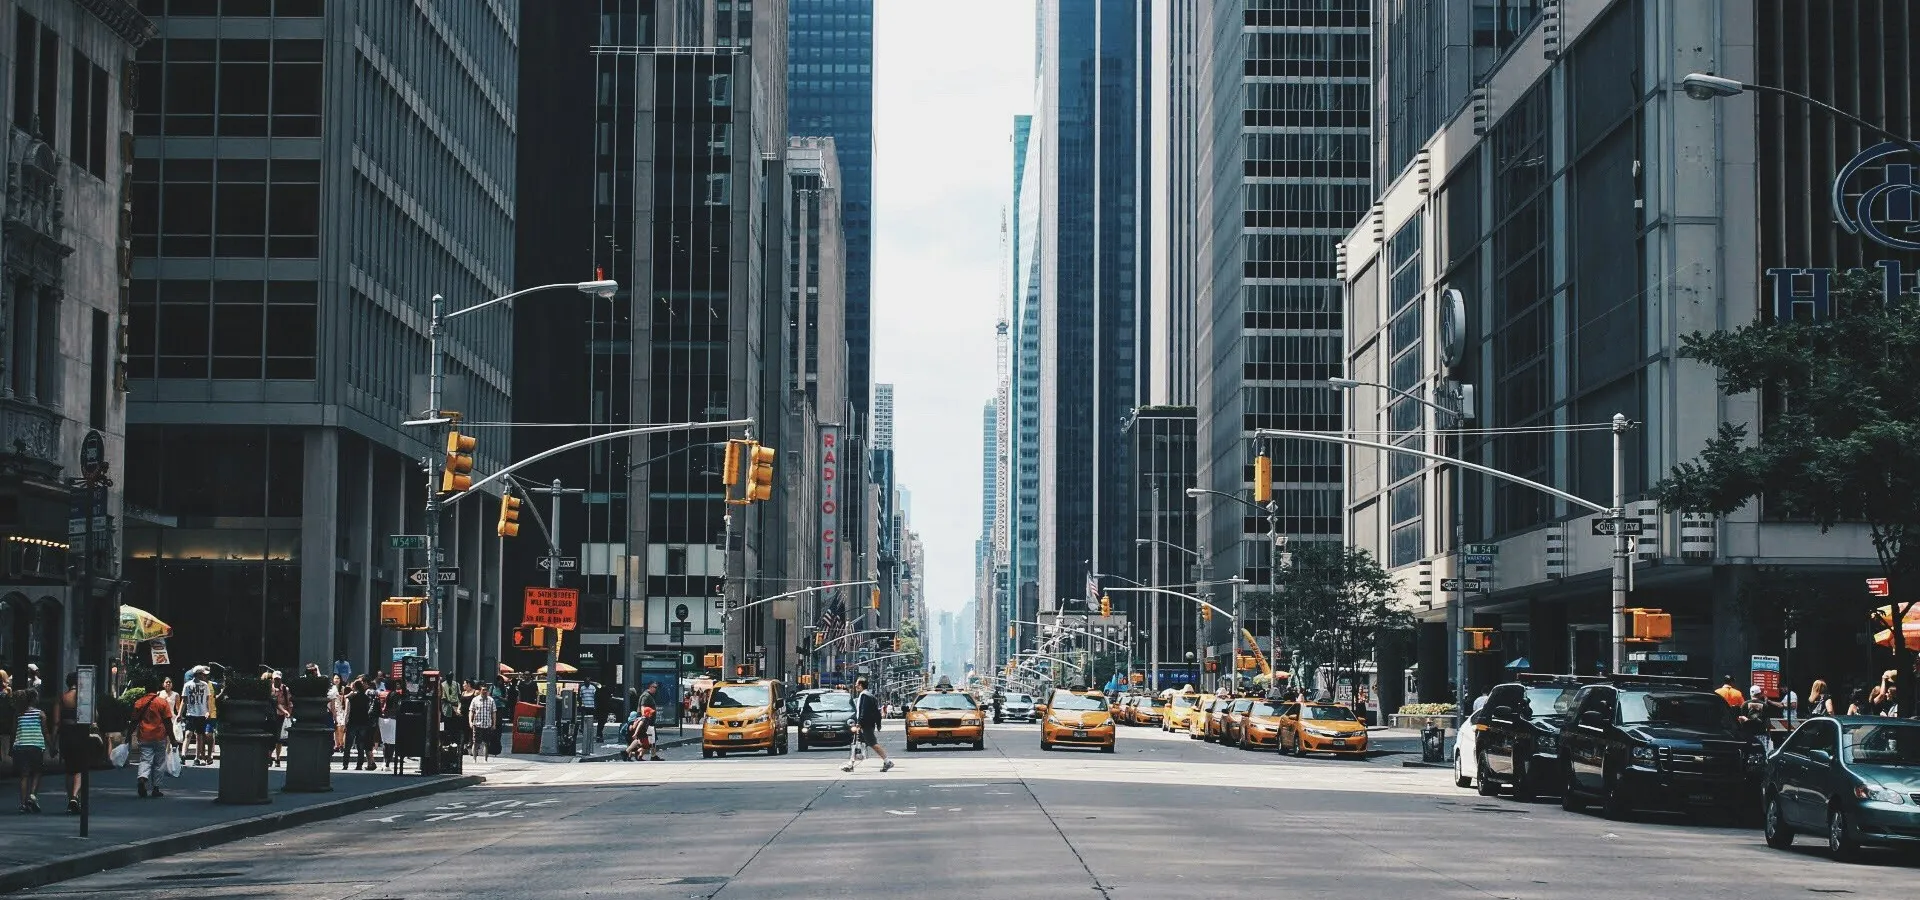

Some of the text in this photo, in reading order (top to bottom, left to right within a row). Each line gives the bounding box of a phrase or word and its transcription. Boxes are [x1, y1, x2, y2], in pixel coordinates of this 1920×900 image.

[822, 433, 835, 593] RADIO CITY
[392, 536, 399, 547] W
[400, 537, 410, 547] 54
[1481, 545, 1491, 554] 54
[553, 591, 576, 599] STREET
[539, 607, 563, 615] BETWEEN
